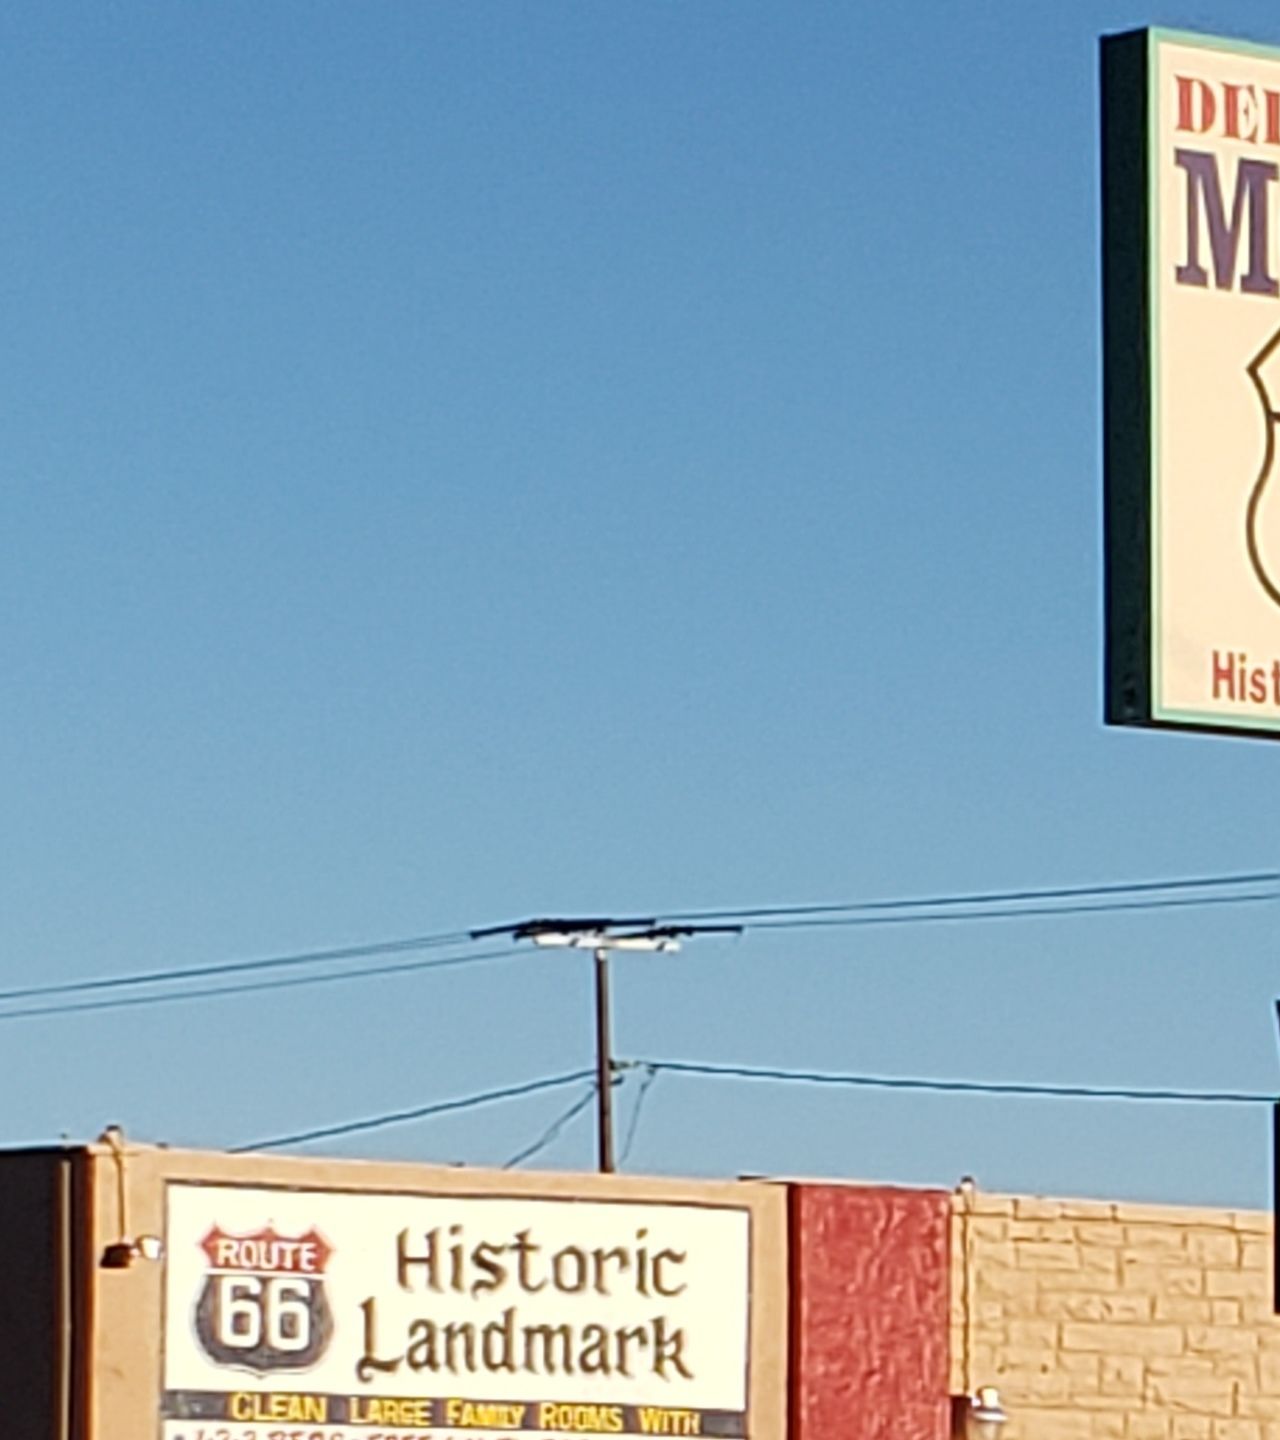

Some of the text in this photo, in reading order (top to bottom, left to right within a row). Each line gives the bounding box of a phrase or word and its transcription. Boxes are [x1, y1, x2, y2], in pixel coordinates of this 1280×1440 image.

[215, 1239, 318, 1271] ROUTE
[397, 1224, 689, 1297] Historic
[219, 1276, 311, 1351] 66
[356, 1297, 695, 1382] Landmark
[230, 1393, 328, 1422] CLEAN
[350, 1398, 433, 1425] LARGE
[540, 1403, 624, 1433] ROOMS
[639, 1408, 700, 1435] WITH
